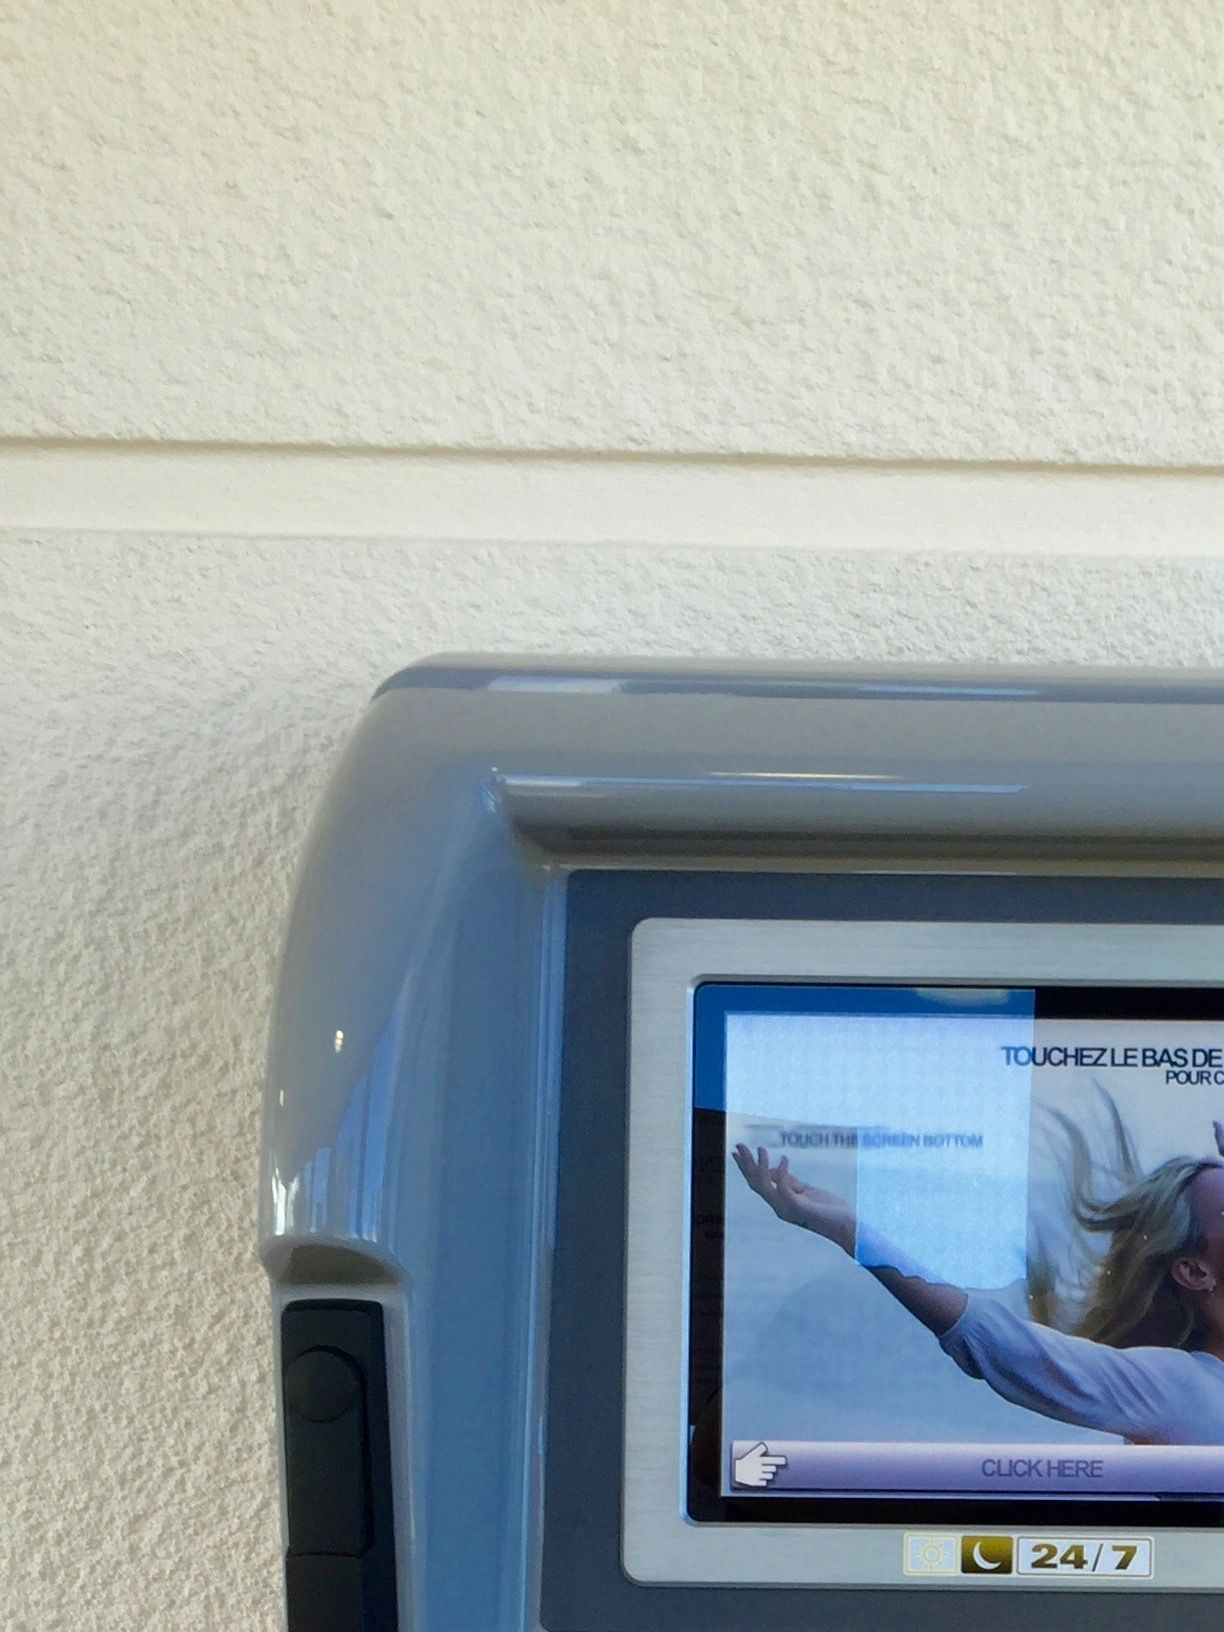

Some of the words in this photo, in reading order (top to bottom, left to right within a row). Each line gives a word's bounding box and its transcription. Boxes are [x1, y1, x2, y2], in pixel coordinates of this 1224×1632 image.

[1001, 1046, 1108, 1067] TOUCHEZ
[1111, 1048, 1138, 1067] LE
[1142, 1048, 1188, 1068] BAS
[1192, 1048, 1223, 1068] DE
[1166, 1070, 1211, 1085] POUR
[780, 1132, 829, 1148] TOUCH
[832, 1133, 858, 1148] THE
[862, 1133, 920, 1148] SCREEN
[923, 1133, 984, 1148] BOTTOM
[981, 1458, 1043, 1478] CLICK
[1048, 1459, 1104, 1478] HERE
[1031, 1543, 1138, 1572] 24/7
